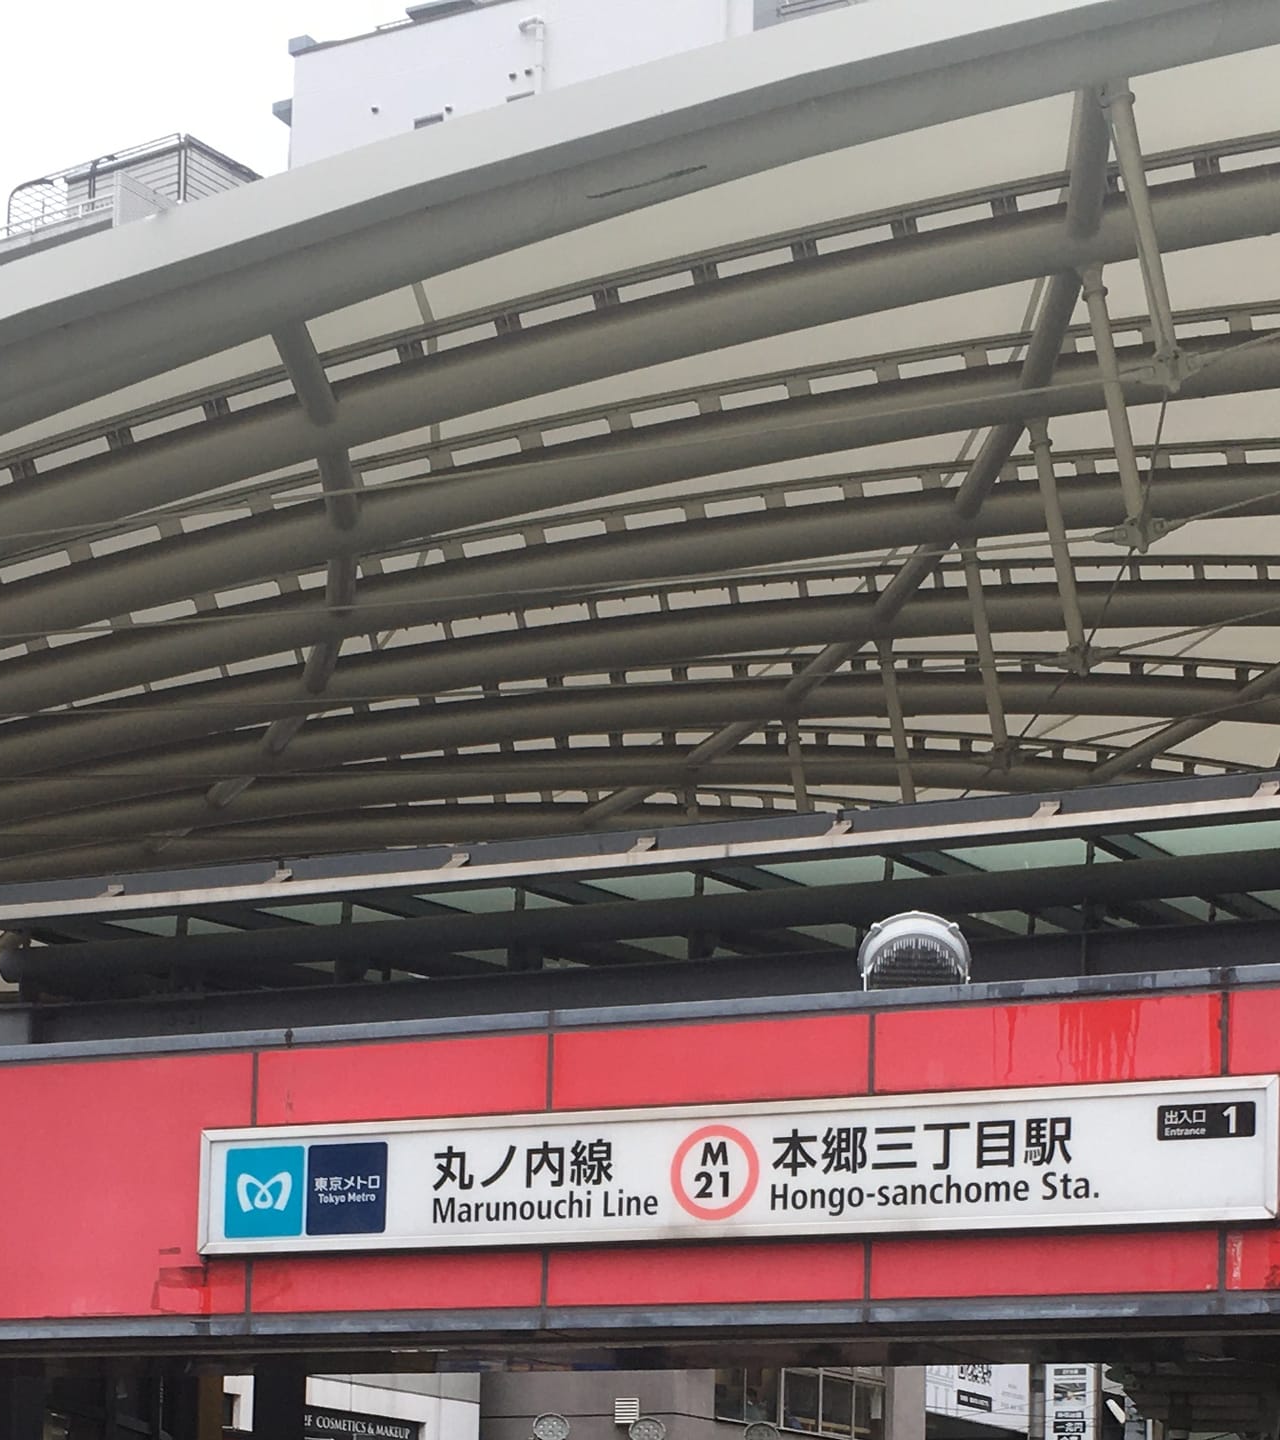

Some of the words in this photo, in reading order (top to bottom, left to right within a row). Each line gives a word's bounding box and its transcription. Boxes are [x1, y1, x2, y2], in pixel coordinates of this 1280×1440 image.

[1164, 1109, 1207, 1125] 出入口
[1222, 1106, 1237, 1135] 1
[1164, 1127, 1207, 1137] Entrance
[701, 1141, 729, 1167] M
[772, 1116, 1073, 1177] 本郷三丁目駅
[432, 1137, 615, 1191] 丸ノ内線
[313, 1174, 381, 1193] 東京メトロ
[694, 1171, 731, 1199] 21
[770, 1174, 1029, 1217] Hongo-sanchome
[1041, 1172, 1100, 1201] Sta.
[318, 1193, 346, 1205] Tokyo
[347, 1191, 376, 1203] Metro
[432, 1190, 593, 1224] Marunouchi
[602, 1189, 659, 1219] Line
[316, 1415, 366, 1433] COSMETICS
[367, 1423, 375, 1434] &
[376, 1425, 411, 1439] MAKEUP
